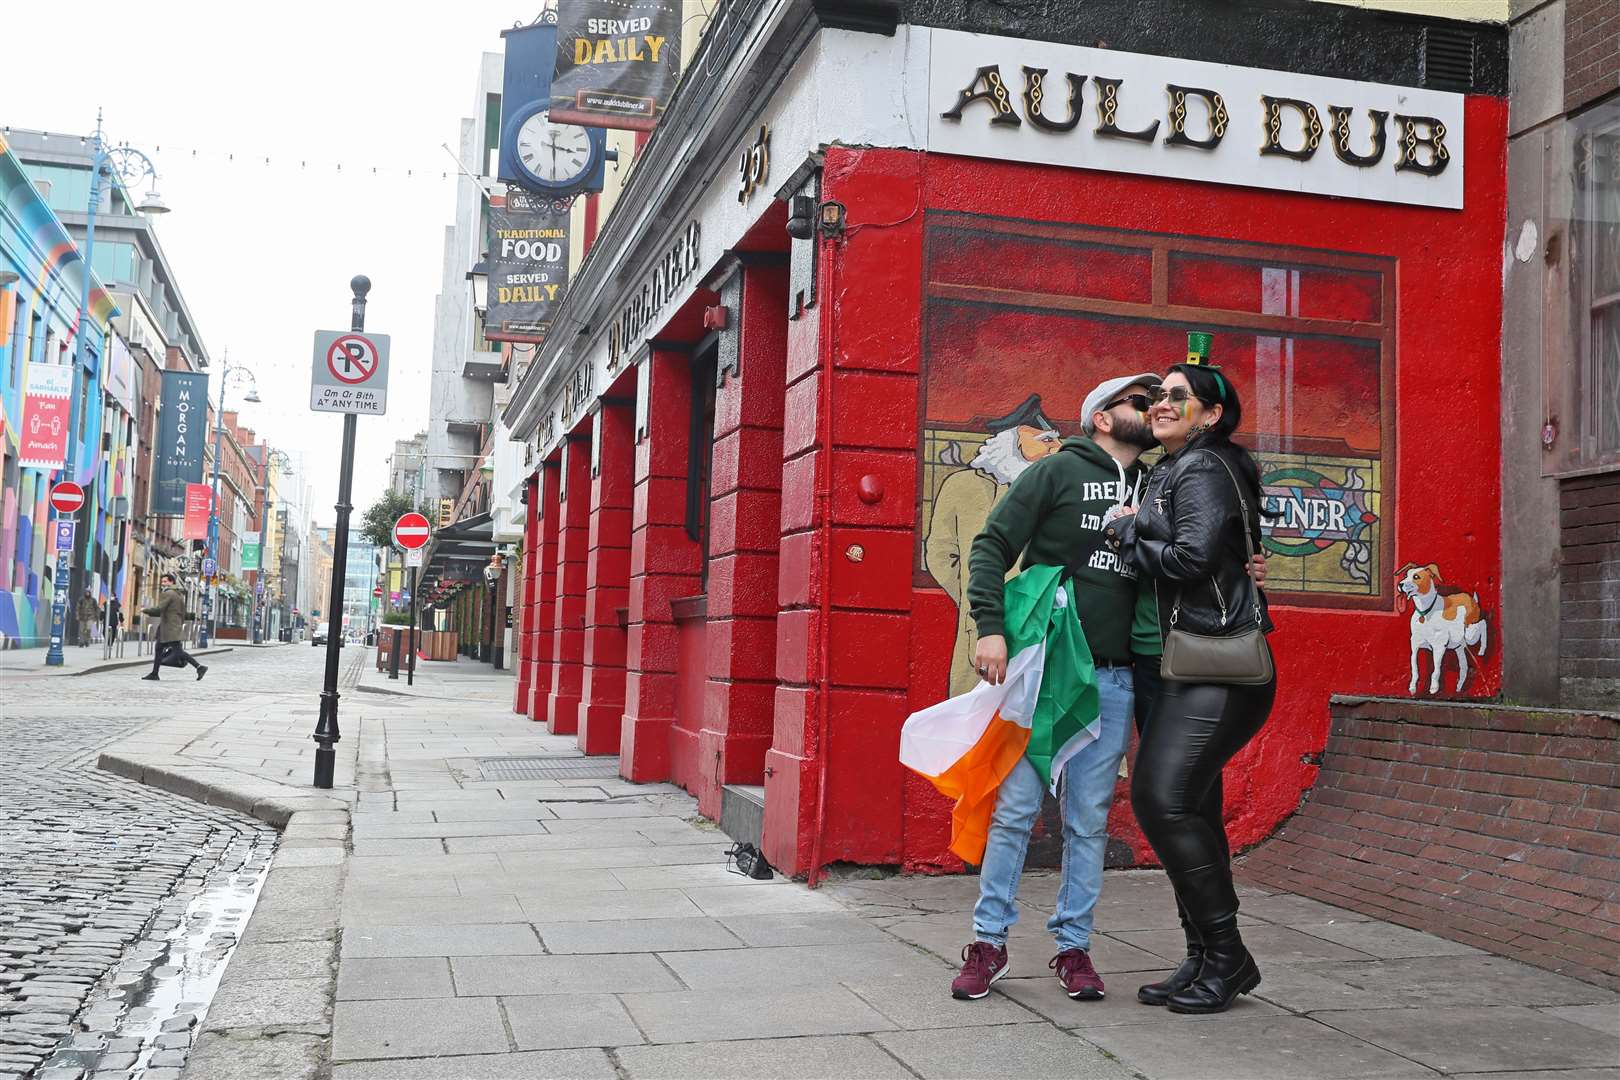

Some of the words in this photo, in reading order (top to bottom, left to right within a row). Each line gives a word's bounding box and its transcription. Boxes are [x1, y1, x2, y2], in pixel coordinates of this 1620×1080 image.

[588, 17, 651, 34] SERVED
[574, 35, 665, 65] DAILY
[939, 64, 1230, 151] AULD
[1259, 94, 1450, 176] DUB
[496, 229, 566, 239] TRADITIONAL
[501, 238, 562, 262] FOOD
[506, 273, 549, 284] SERVED
[498, 284, 559, 304] DAILY
[355, 391, 374, 400] Bith
[332, 400, 352, 408] ANY
[355, 401, 378, 410] TIME
[175, 390, 190, 456] MORGAN
